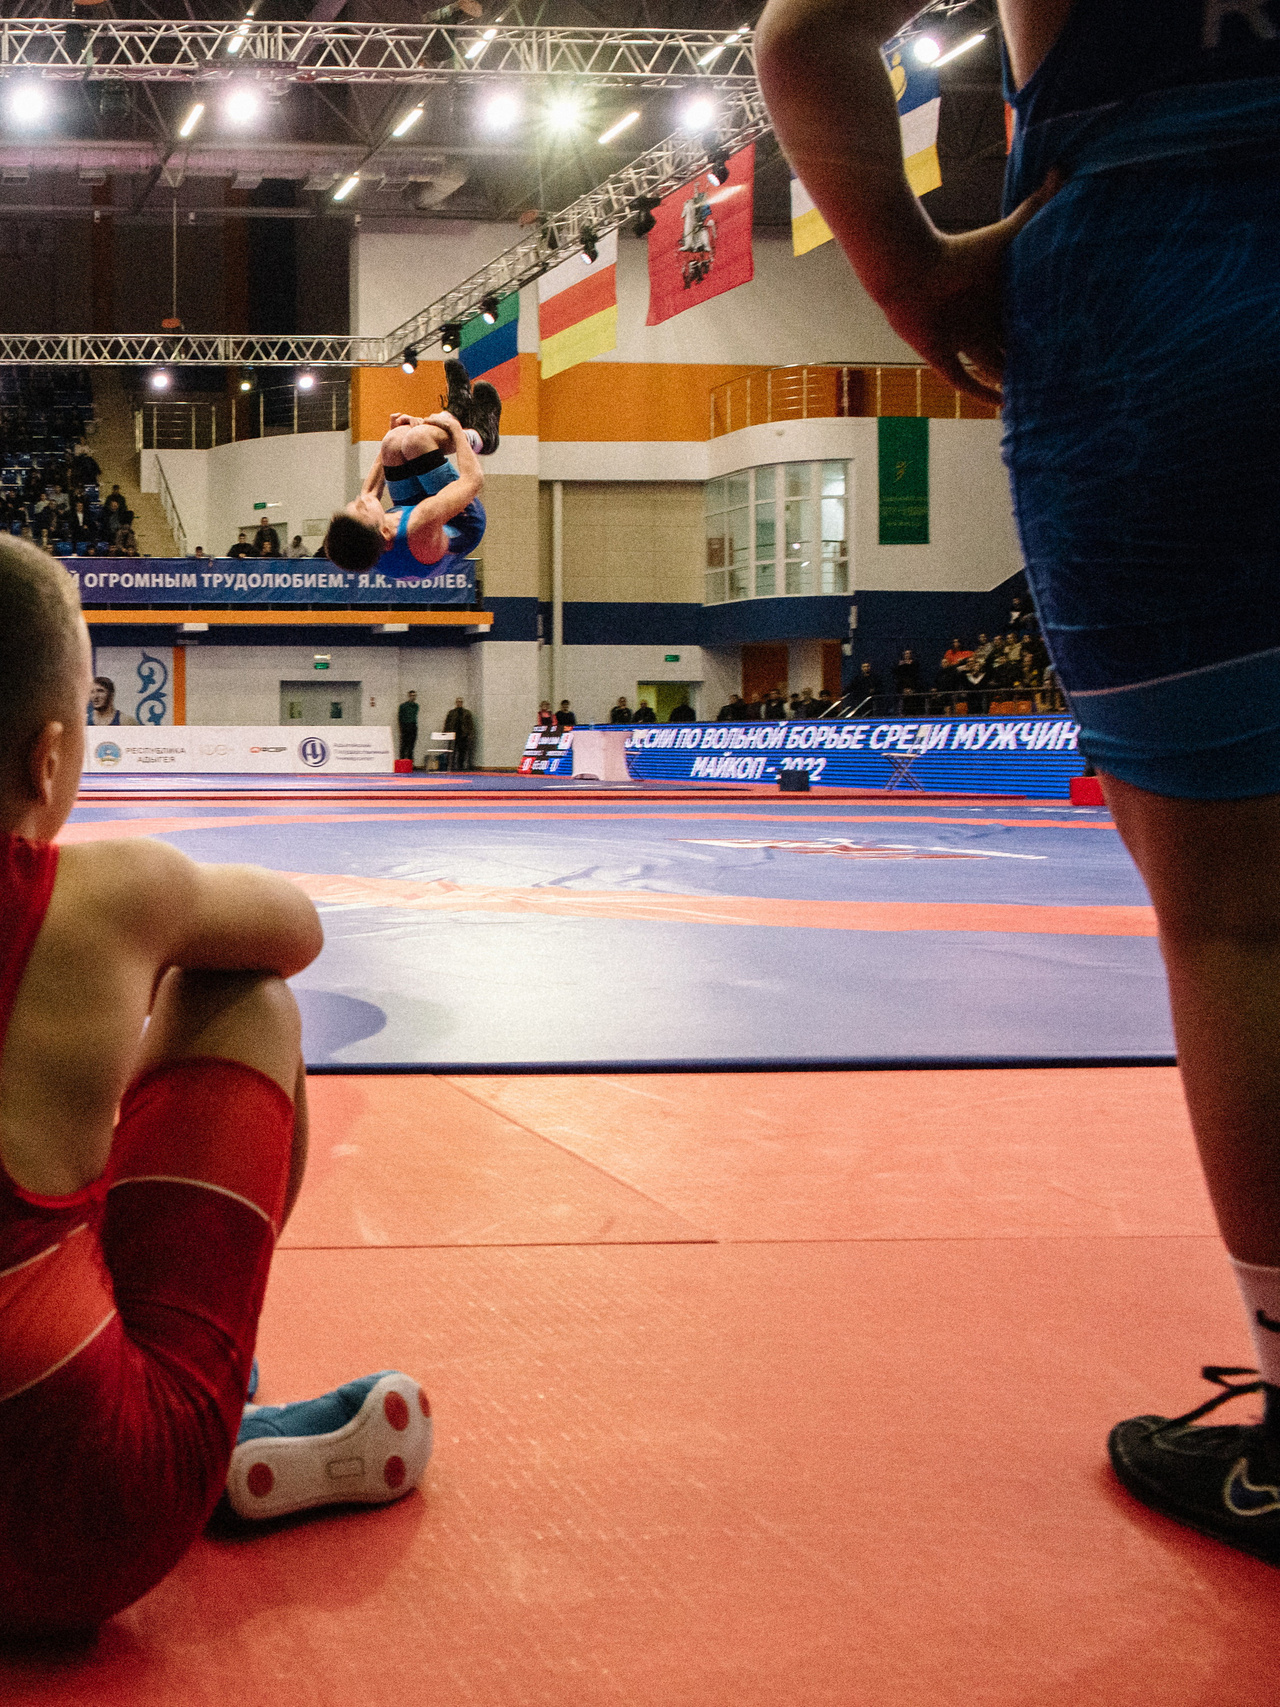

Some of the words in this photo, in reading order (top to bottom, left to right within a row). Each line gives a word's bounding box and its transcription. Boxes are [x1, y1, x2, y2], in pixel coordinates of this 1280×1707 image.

[84, 573, 198, 588] ОГРОМНЫМ
[358, 573, 393, 588] Я.К.
[674, 728, 703, 749] ПО
[700, 720, 788, 750] ВОЛЬНОЙ
[784, 725, 871, 750] БОРЬБЕ
[950, 720, 1081, 751] МУЖЧИН
[690, 751, 769, 780] МАЙКОП
